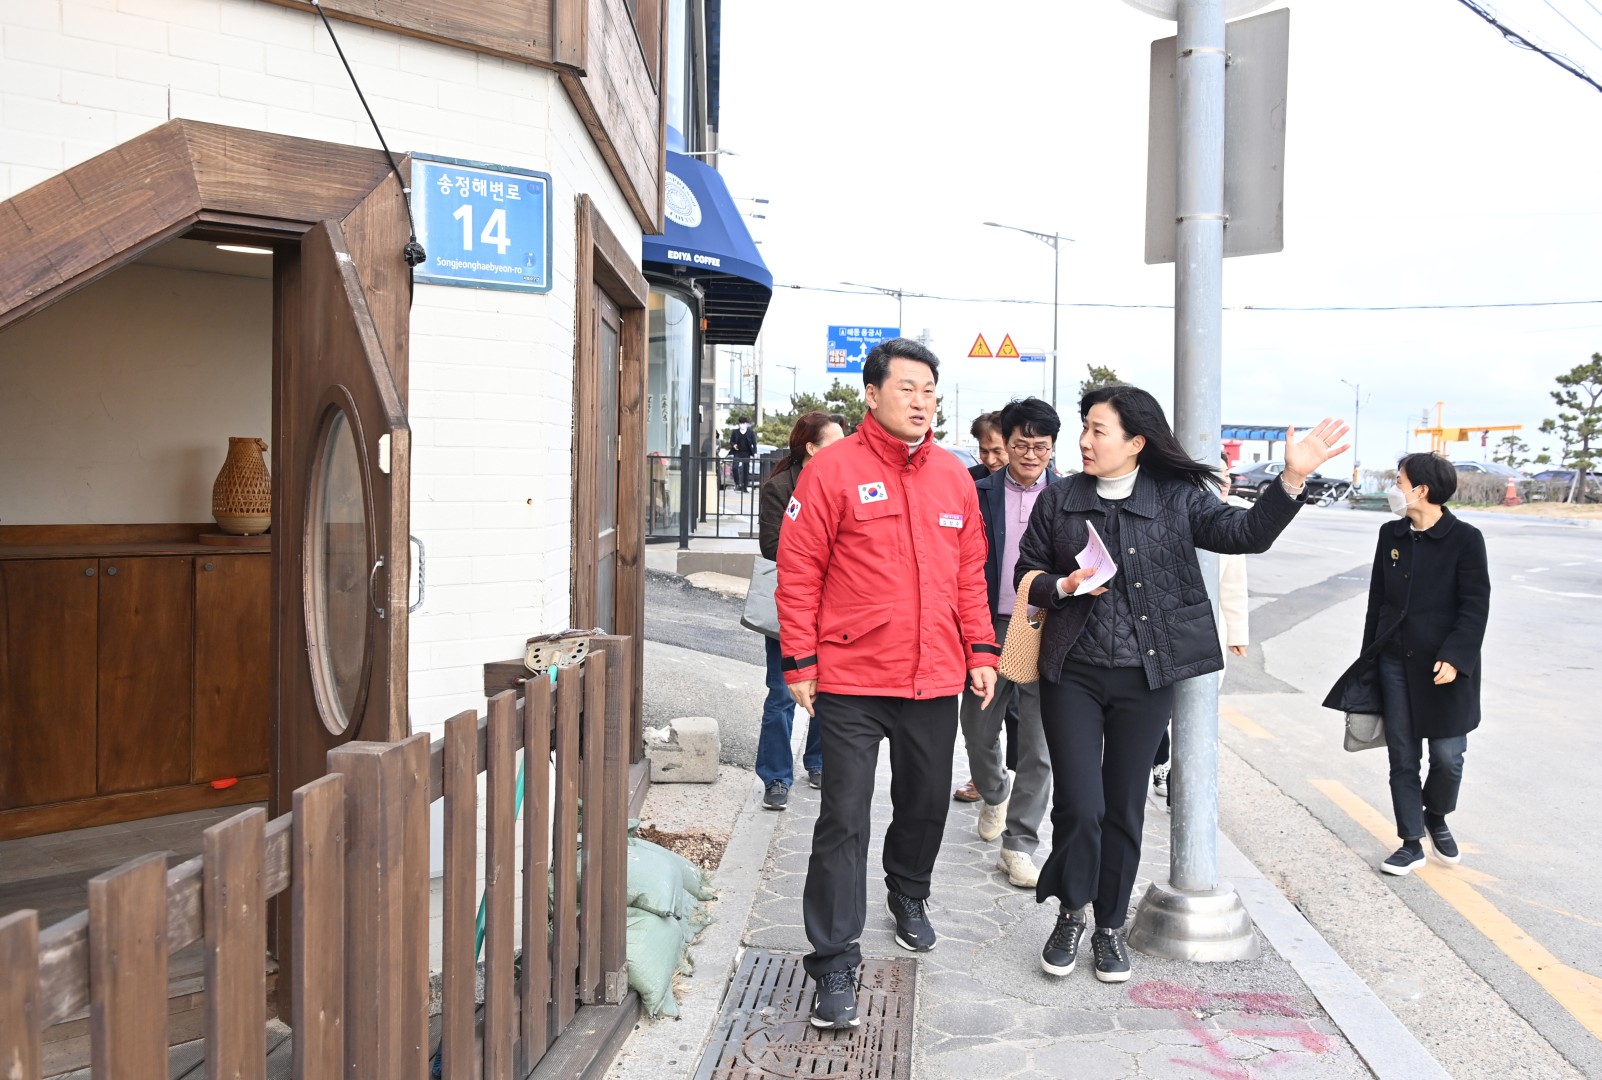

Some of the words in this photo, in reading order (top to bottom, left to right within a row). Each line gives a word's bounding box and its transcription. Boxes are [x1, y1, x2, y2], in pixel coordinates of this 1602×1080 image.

[437, 173, 521, 202] 송정해변로
[452, 204, 511, 255] 14
[437, 257, 522, 274] Songjeonghaebyeon-ro
[668, 250, 692, 261] EDIYA
[694, 254, 720, 267] COFFEE
